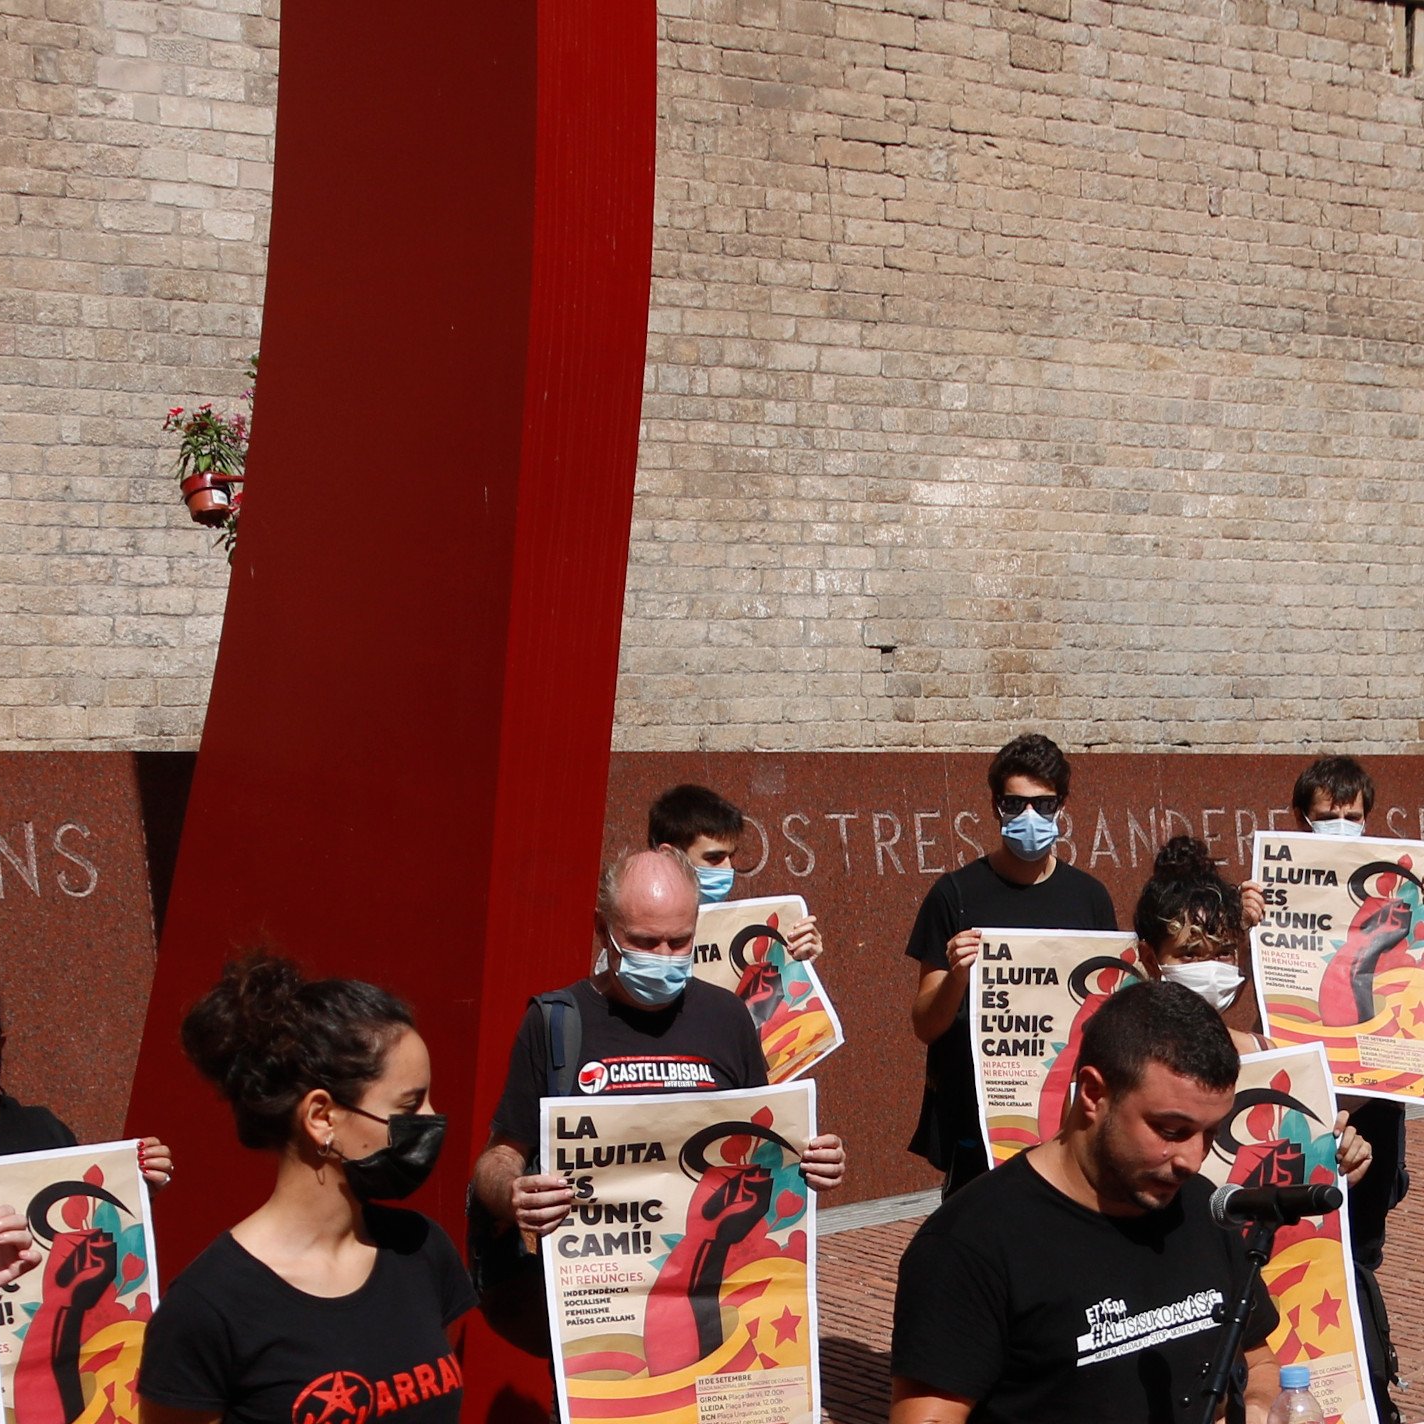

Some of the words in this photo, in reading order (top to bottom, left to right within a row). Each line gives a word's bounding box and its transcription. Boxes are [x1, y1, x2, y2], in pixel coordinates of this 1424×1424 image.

[736, 810, 985, 877] OSTRES
[1263, 844, 1292, 861] LA
[1262, 866, 1338, 888] LLUITA
[1263, 886, 1287, 906] ÉS
[1261, 907, 1333, 932] L'ÚNIC
[1260, 928, 1324, 952] CAMÍ!
[982, 943, 1012, 961] LA
[982, 967, 1059, 985] LLUITA
[981, 985, 1009, 1009] ÉS
[981, 1009, 1053, 1034] L'ÚNIC
[981, 1031, 1045, 1057] CAMÍ!
[610, 1062, 716, 1083] CASTELLBISBAL
[992, 1061, 1021, 1069] PACTES
[556, 1115, 598, 1140] LA
[556, 1142, 666, 1170] LLUITA
[557, 1223, 652, 1259] CAMÍ!
[560, 1265, 572, 1275] NI
[574, 1262, 619, 1273] PACTES
[560, 1276, 574, 1286] NI
[576, 1270, 646, 1285] RENÚNCIES,
[563, 1286, 630, 1298] INDEPENDÈNCIA
[564, 1297, 612, 1307] SOCIALISME
[565, 1307, 610, 1317] FEMINISME
[566, 1316, 595, 1326] PAÏSOS
[595, 1314, 636, 1324] CATALANS
